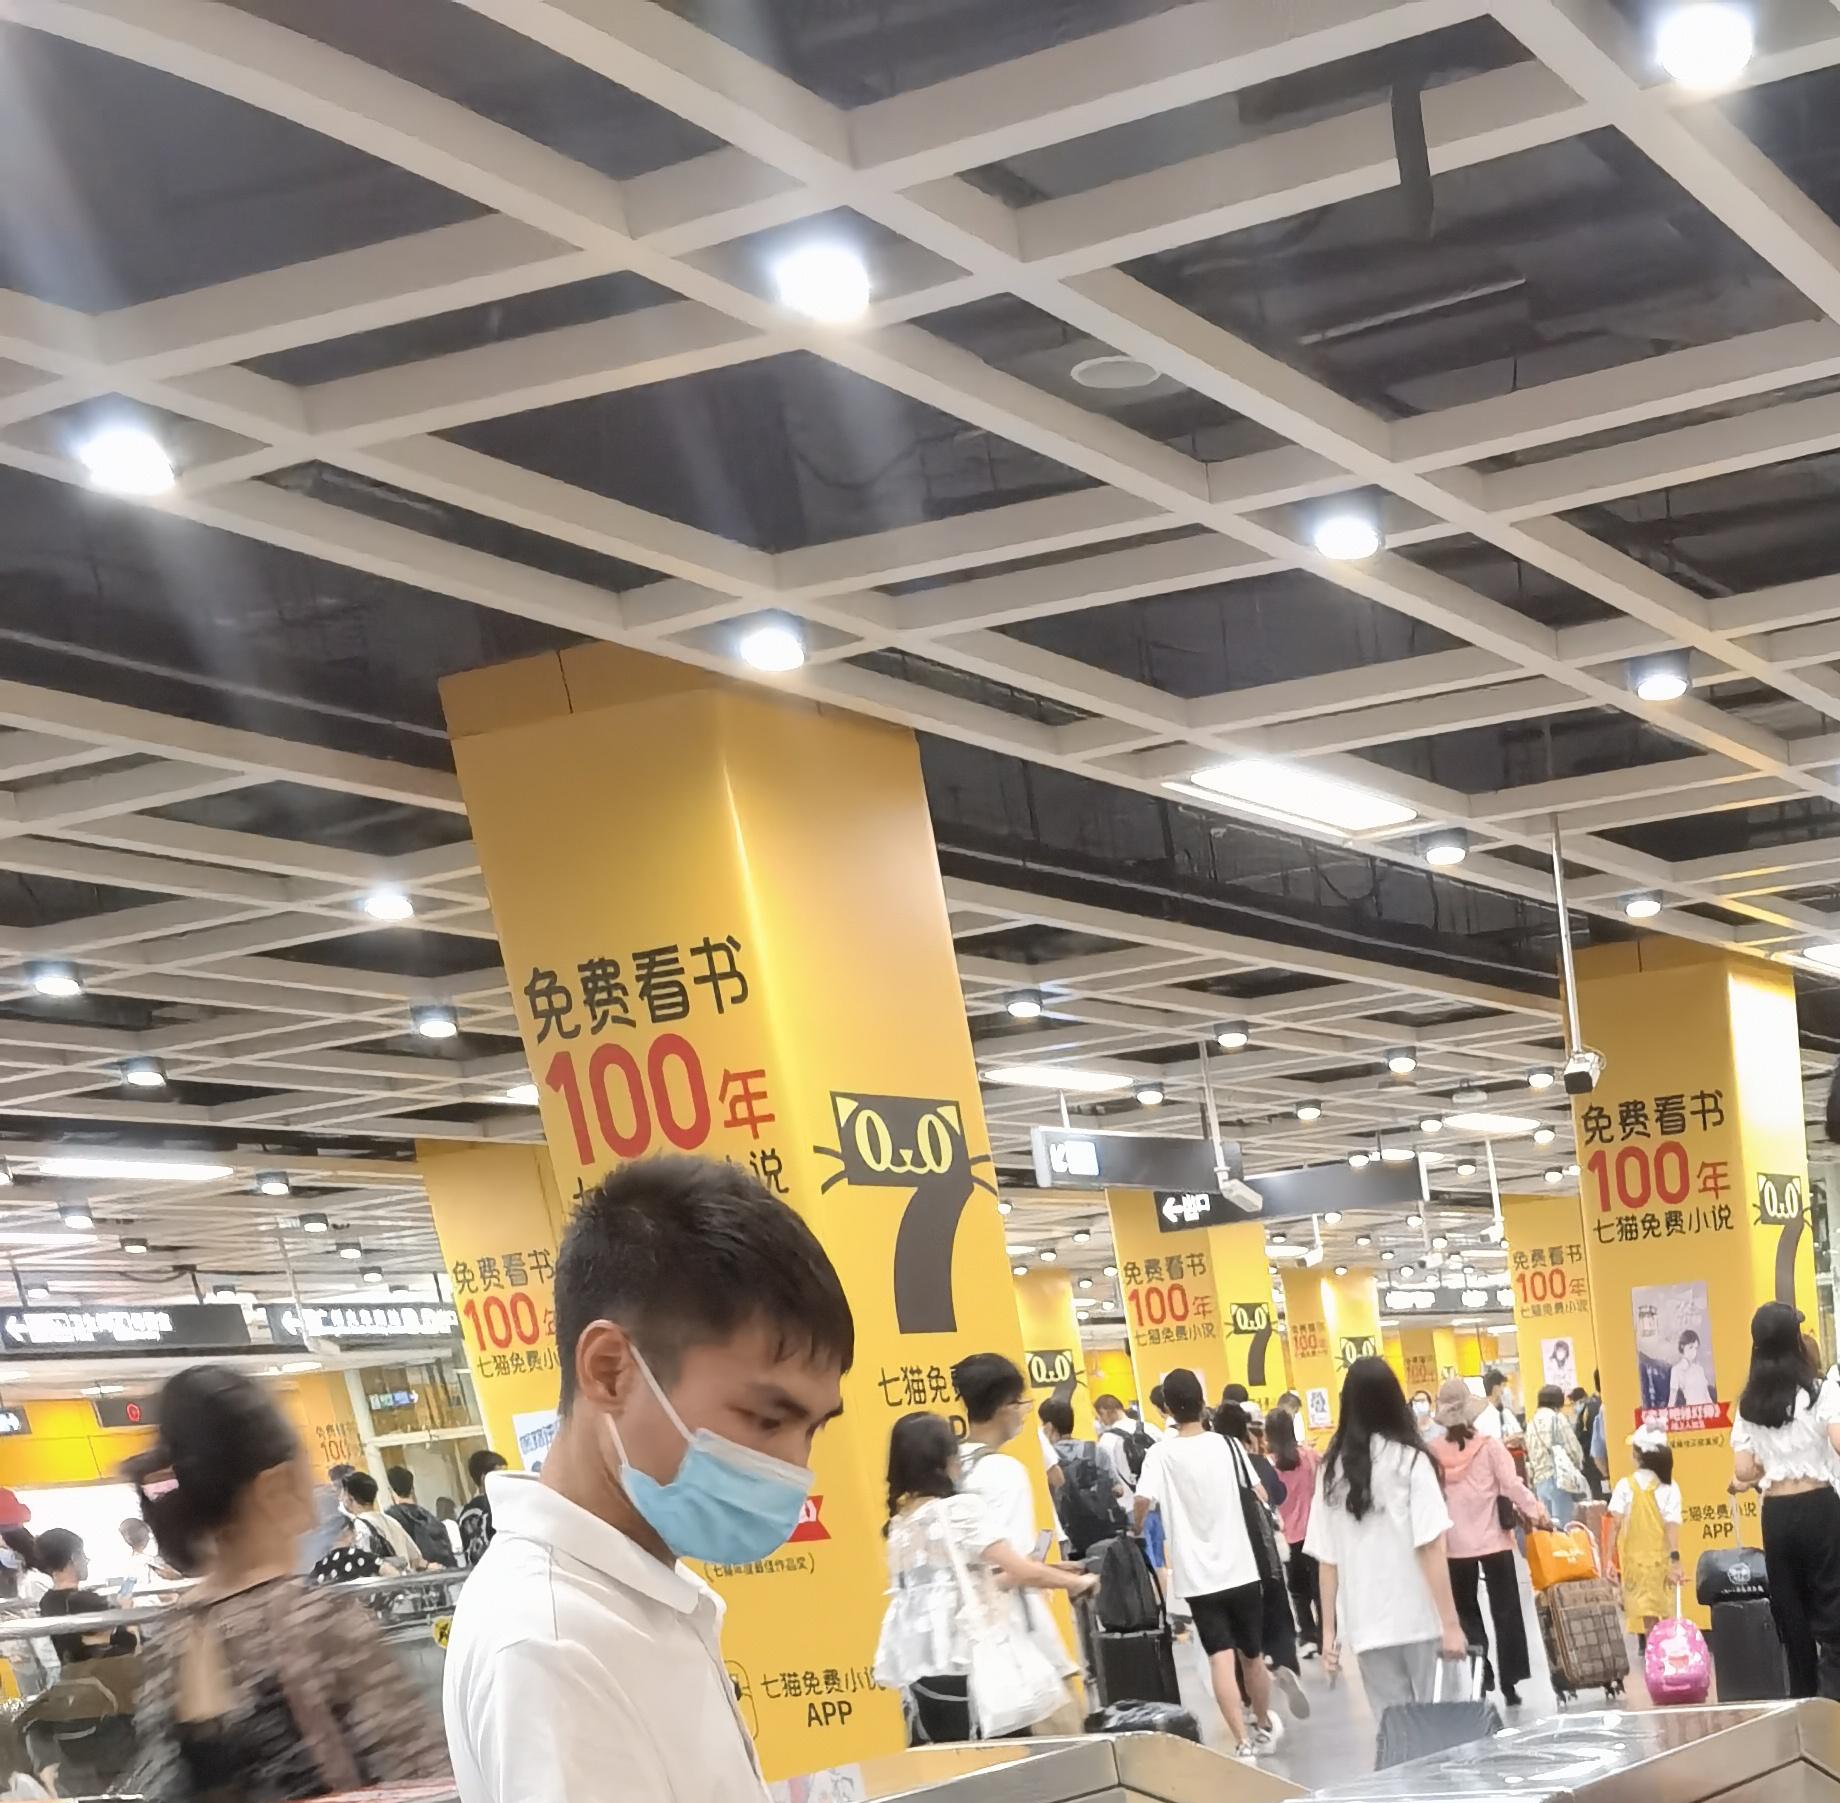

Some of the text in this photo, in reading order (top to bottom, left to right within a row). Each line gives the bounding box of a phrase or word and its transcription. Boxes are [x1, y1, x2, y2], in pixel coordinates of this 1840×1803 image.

[523, 934, 749, 1045] 免费看书
[545, 1033, 776, 1166] 100年
[1581, 1089, 1725, 1146] 免费看书
[1587, 1140, 1732, 1213] 100年
[1592, 1203, 1735, 1245] 七猫免费小说
[1122, 1252, 1207, 1287] 免费看书
[1126, 1283, 1214, 1327] 100年
[1702, 1522, 1734, 1547] APP
[807, 1700, 853, 1728] APP
